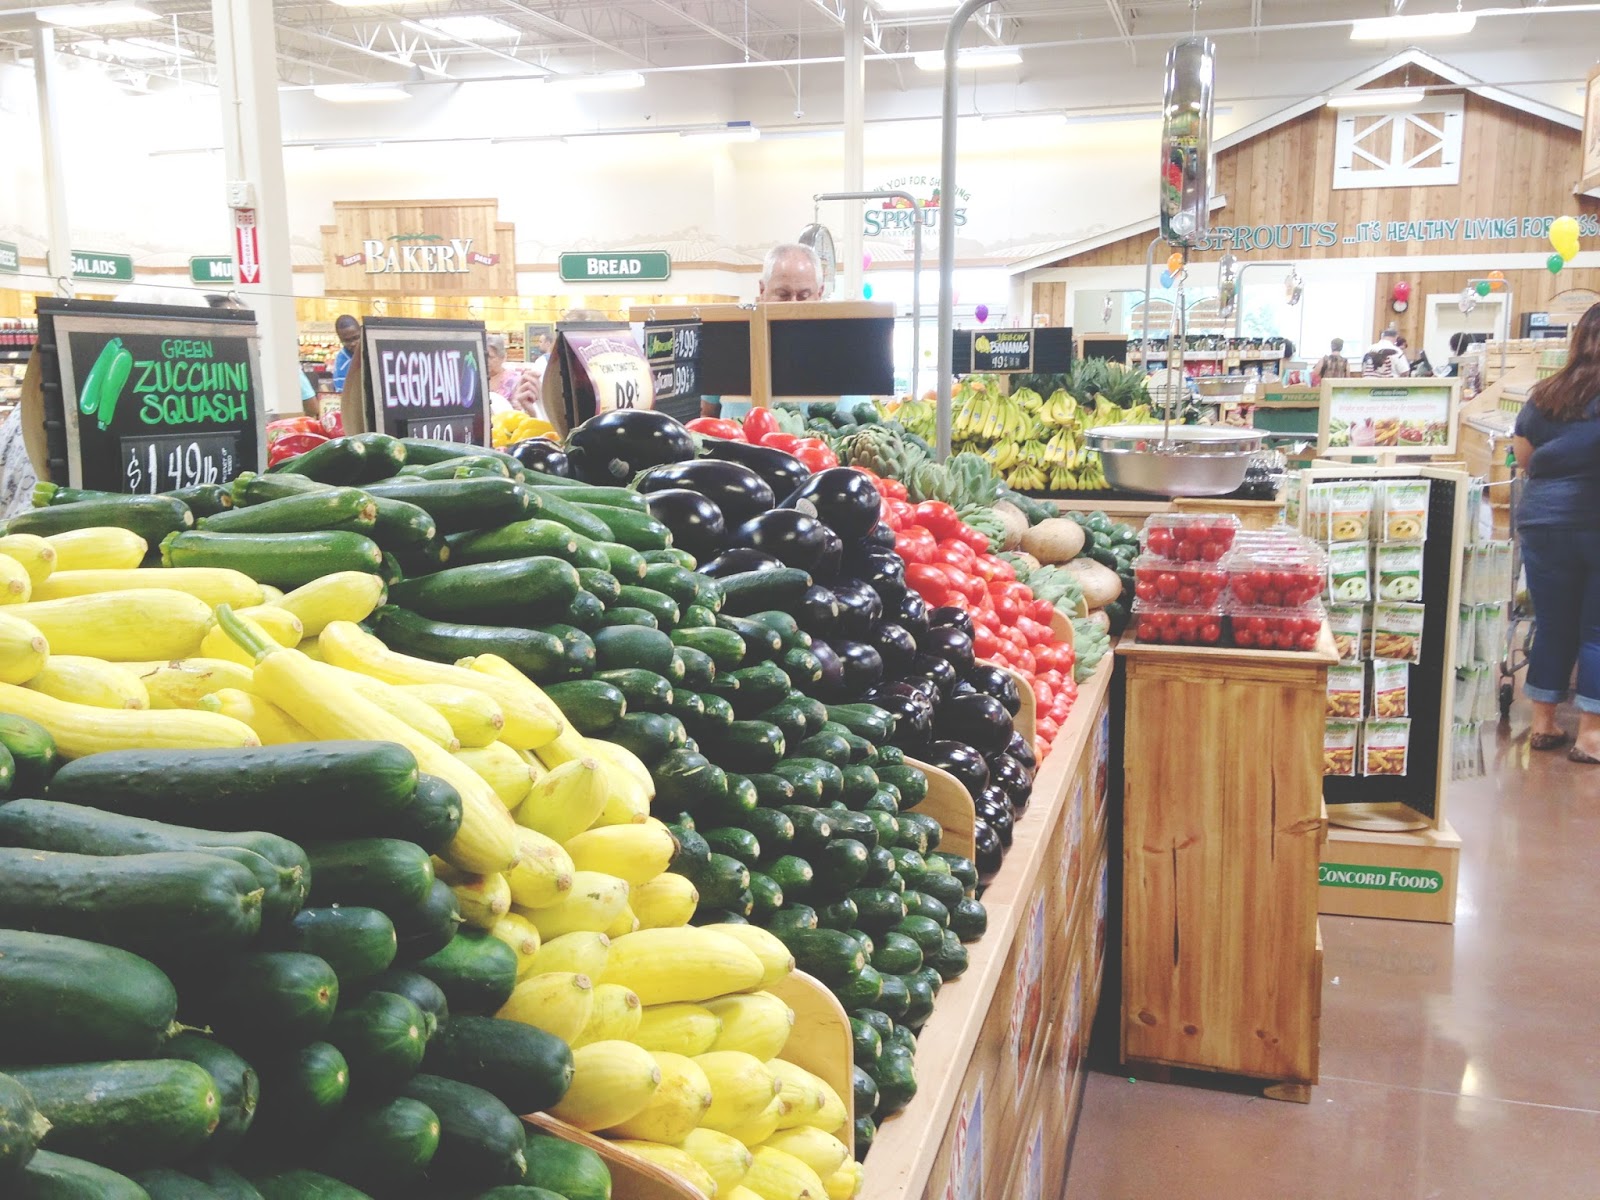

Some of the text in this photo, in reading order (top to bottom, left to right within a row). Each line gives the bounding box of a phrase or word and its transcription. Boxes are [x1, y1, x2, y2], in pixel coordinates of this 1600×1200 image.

[886, 176, 971, 202] YOU FOR SHING
[863, 208, 967, 236] SPROUS
[1193, 222, 1338, 251] SPROUTS
[1387, 218, 1459, 242] HEALTHY
[1463, 216, 1518, 240] LIVING
[362, 238, 473, 274] BAKERY
[587, 257, 641, 275] BREAD
[161, 338, 213, 359] GREEN
[990, 341, 1029, 354] BANANAS
[133, 360, 249, 394] ZUCCHINI
[382, 350, 460, 408] EGGPLANT
[139, 394, 248, 425] SQUASH
[1318, 866, 1438, 889] CONCORD FOODS
